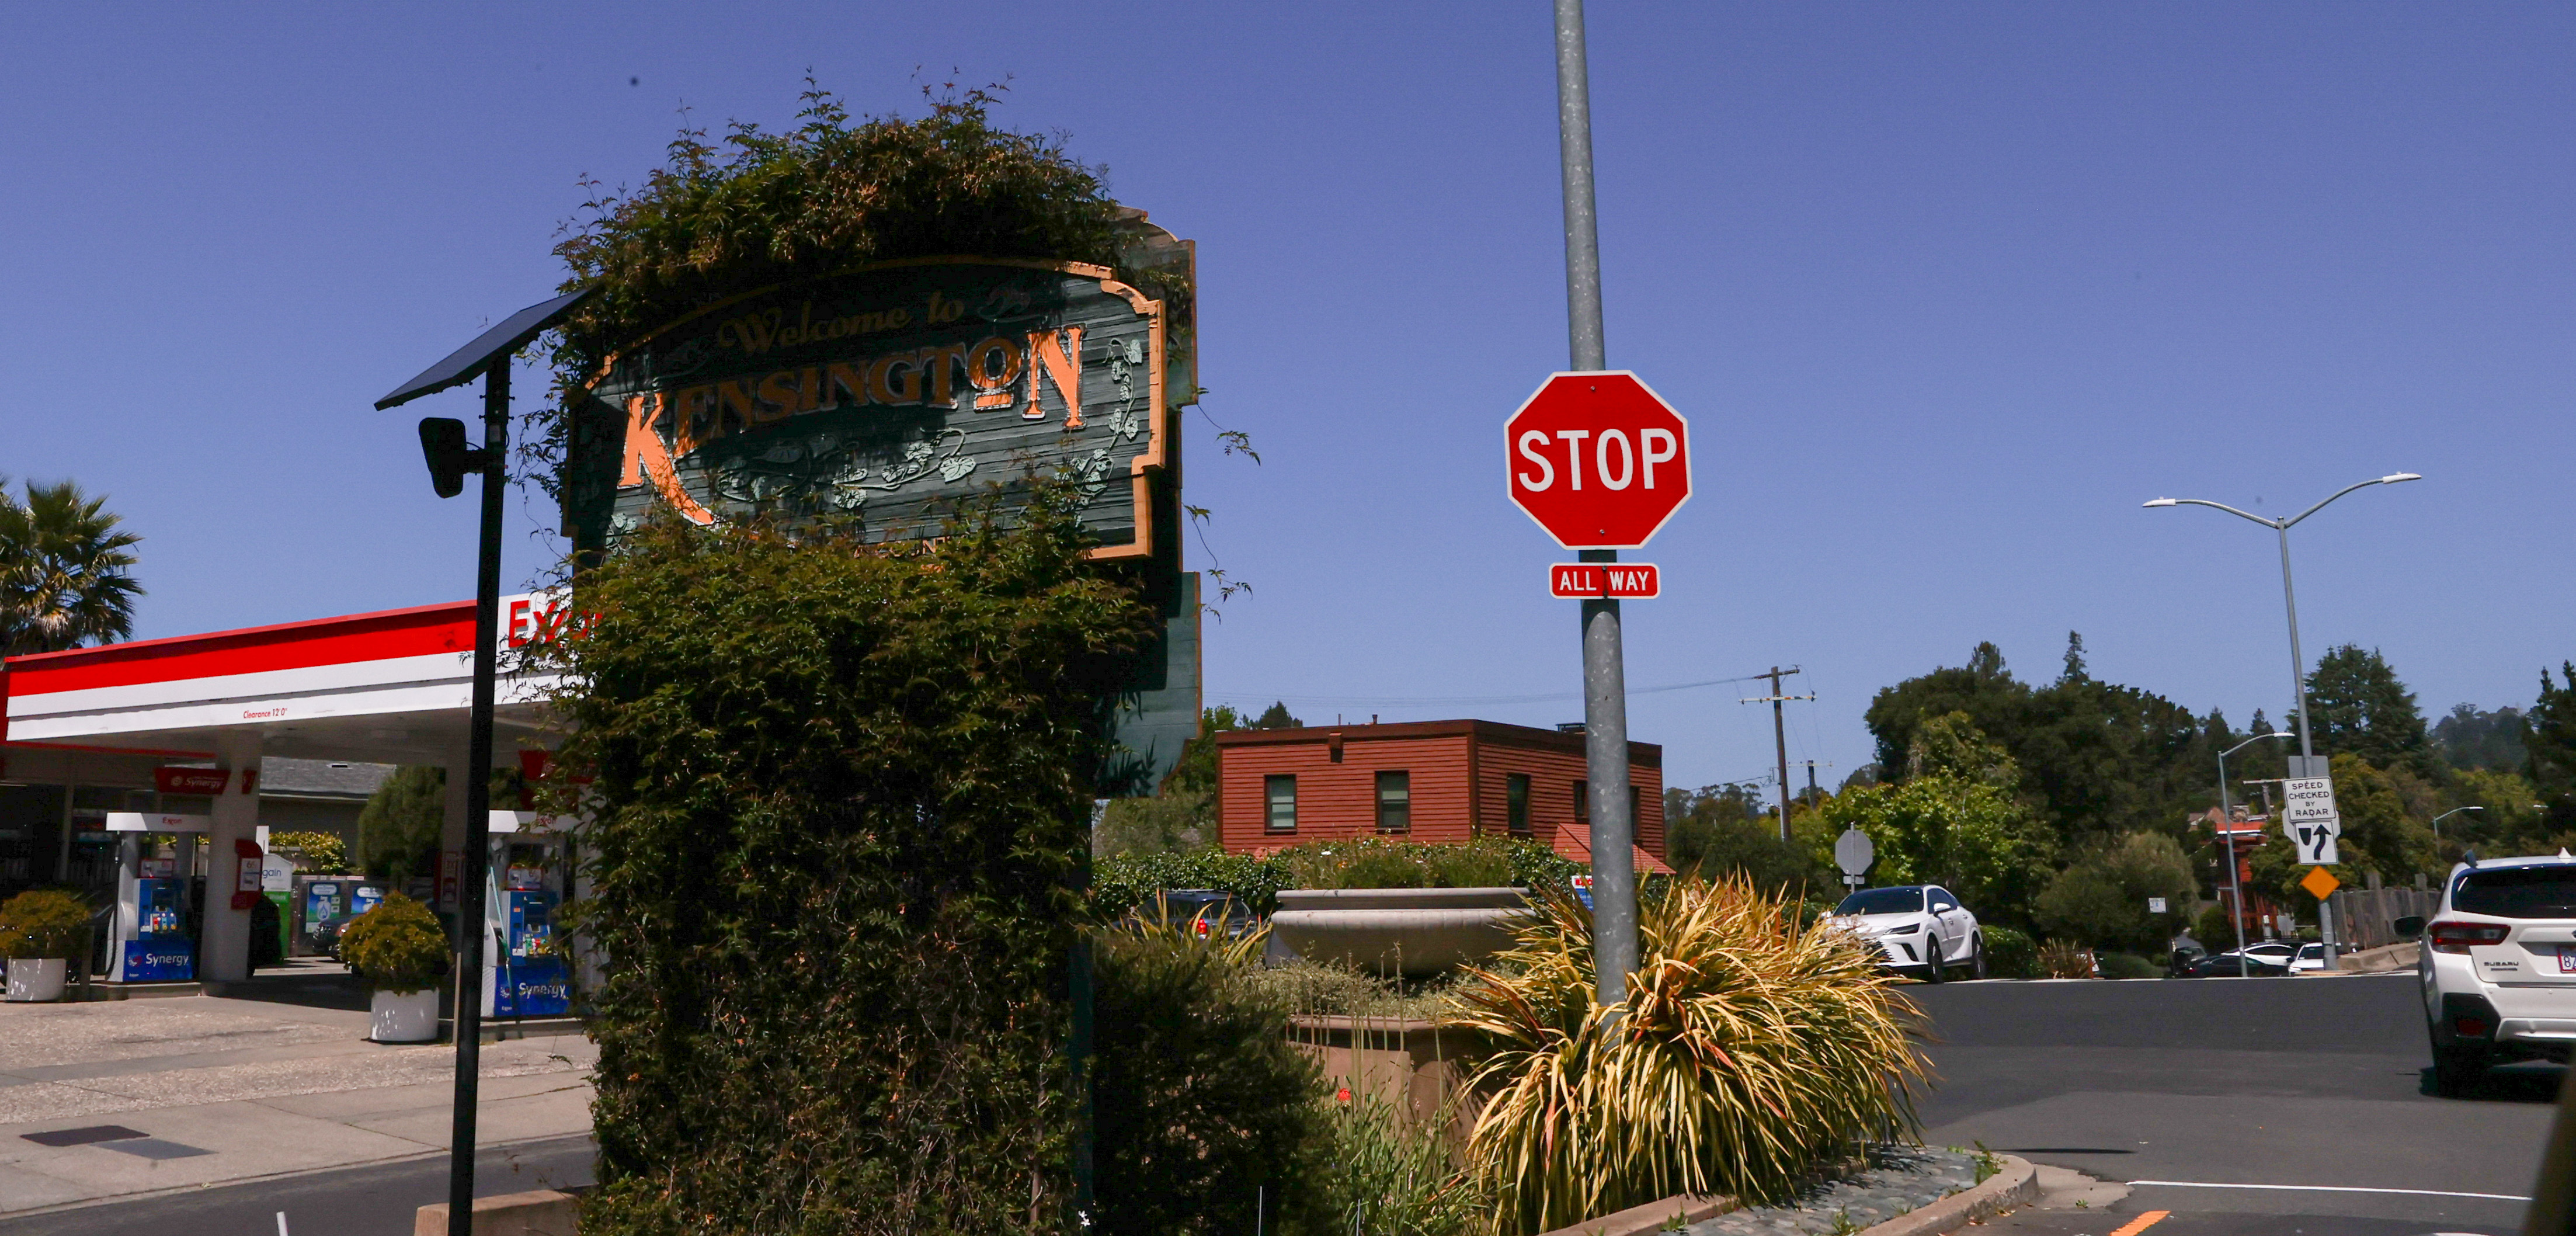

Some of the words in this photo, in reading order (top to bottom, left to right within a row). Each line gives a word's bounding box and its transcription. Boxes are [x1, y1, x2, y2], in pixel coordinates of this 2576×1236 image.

[718, 300, 912, 353] Welcome
[927, 290, 965, 324] to
[617, 323, 1087, 527] KENSINGTON
[1518, 428, 1677, 492] STOP
[1559, 571, 1597, 591] ALL
[1609, 571, 1649, 591] WAY
[243, 710, 271, 719] Clearance
[185, 777, 224, 789] Synergy
[2292, 782, 2323, 790] SPEED
[2289, 791, 2330, 800] CHECKED
[2296, 808, 2328, 817] RADAR
[145, 953, 189, 967] Synergy
[519, 982, 566, 999] Synergy
